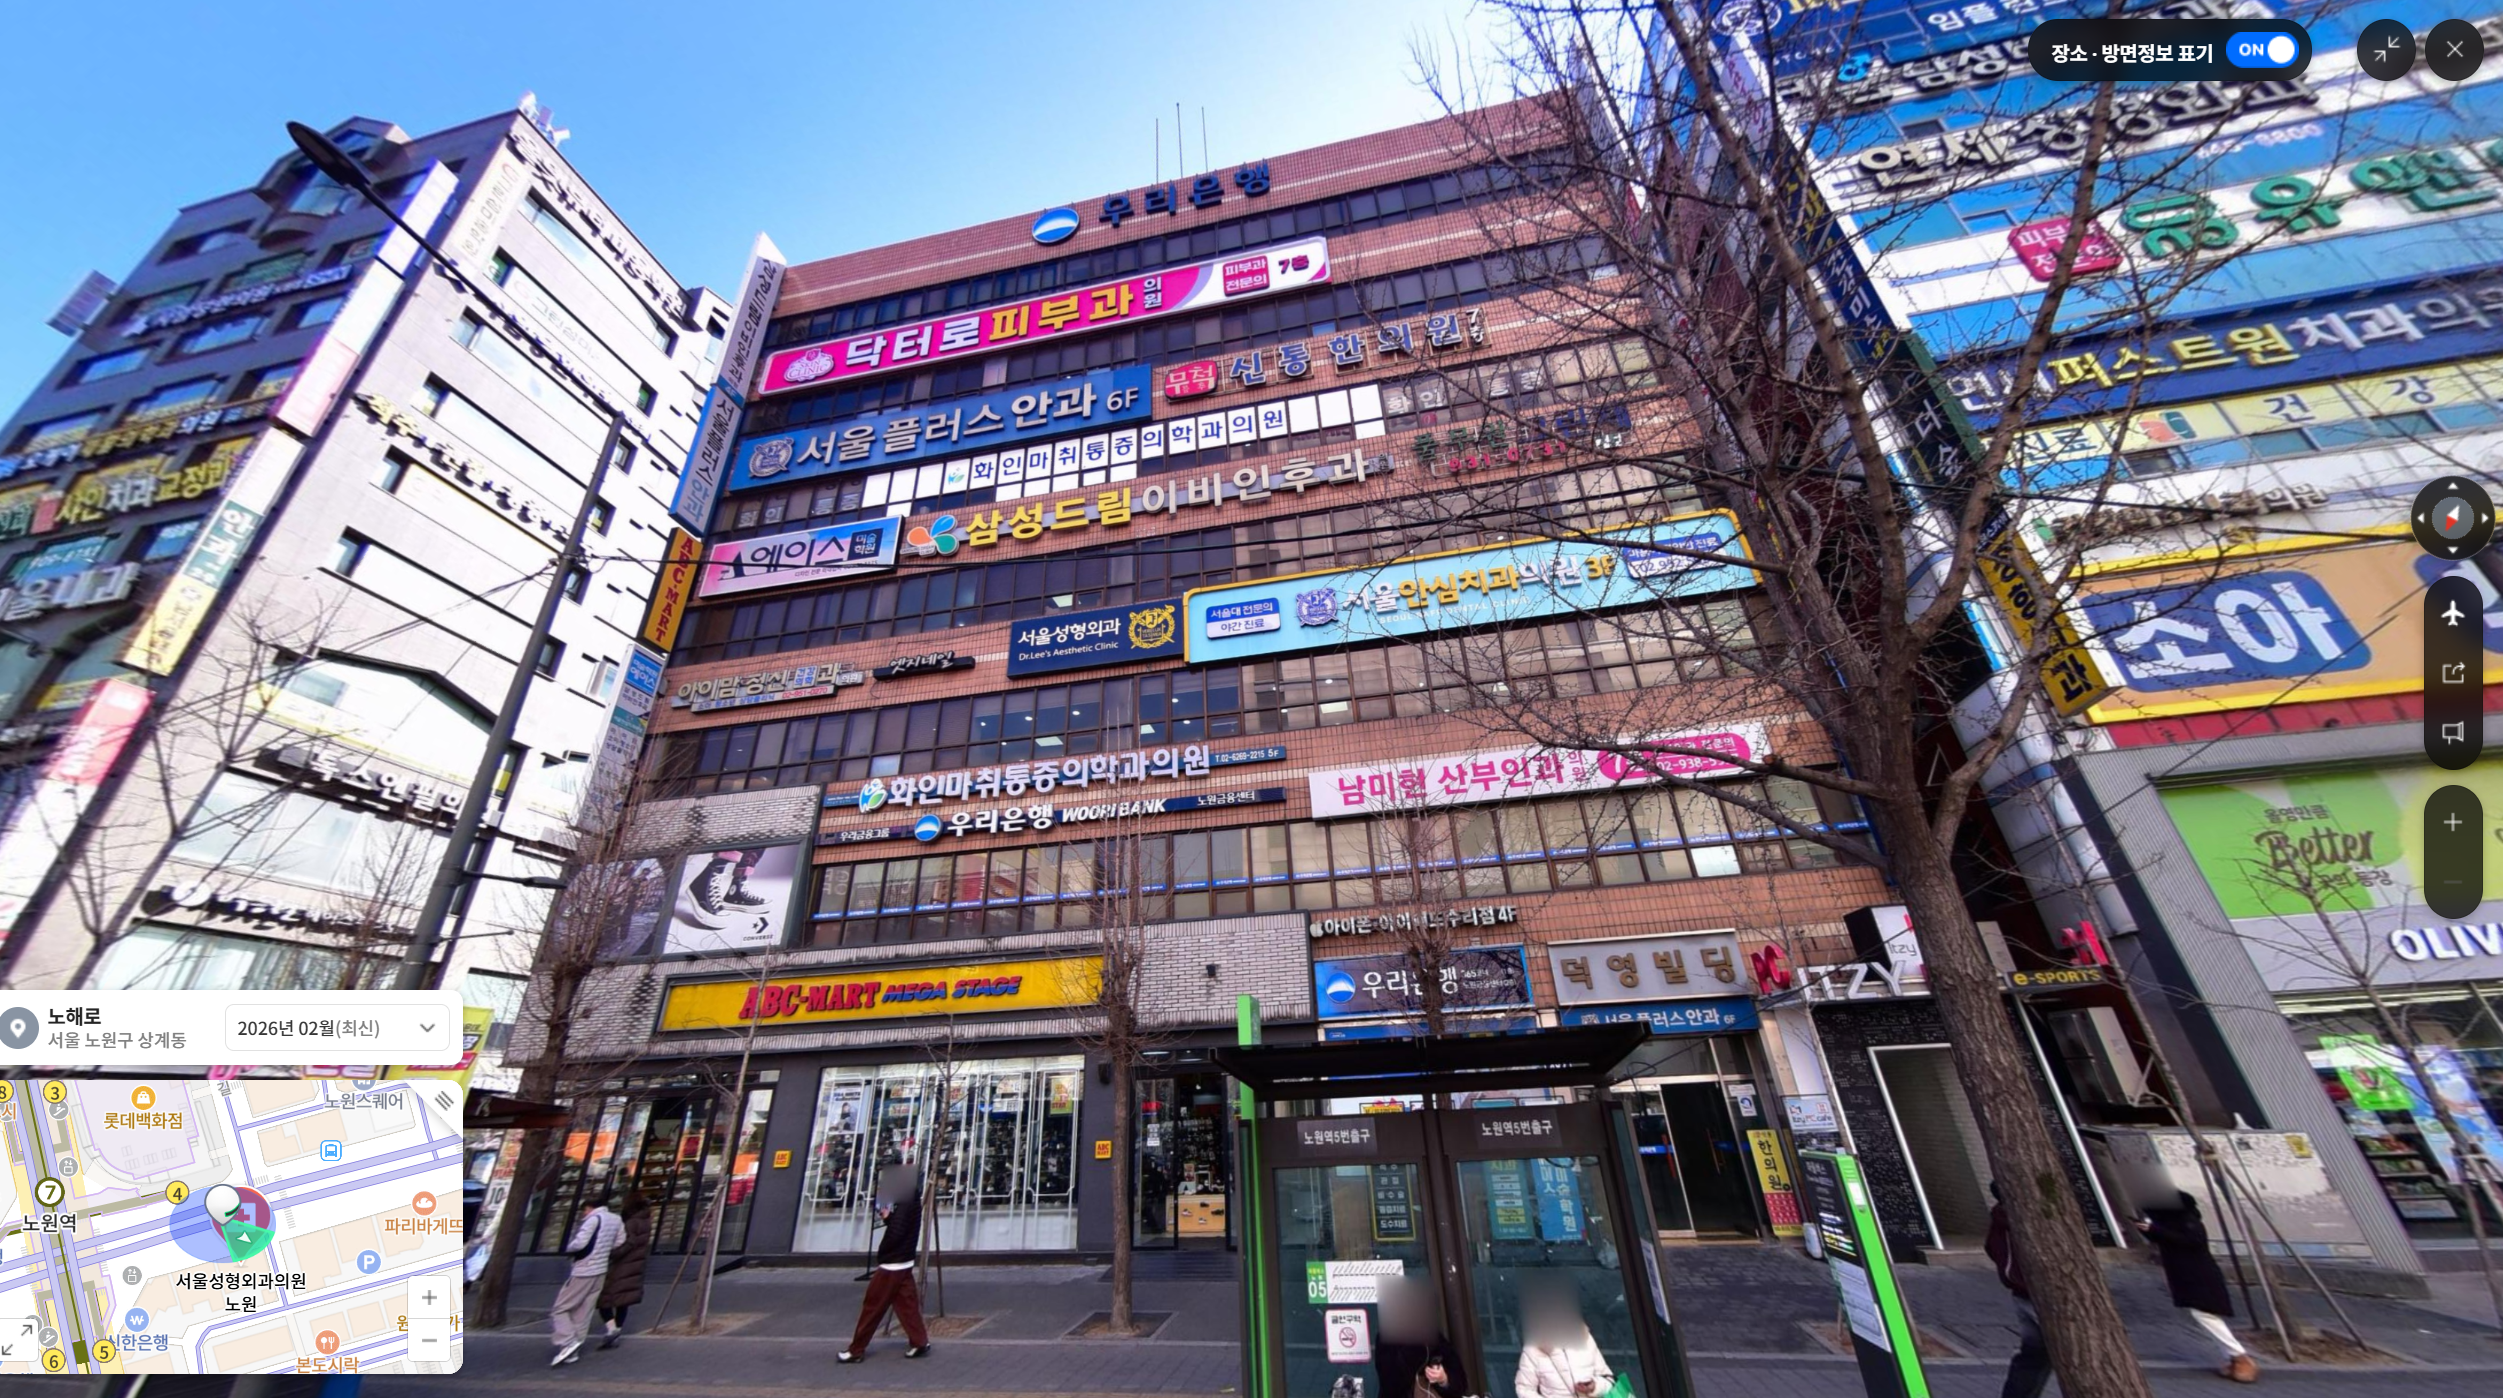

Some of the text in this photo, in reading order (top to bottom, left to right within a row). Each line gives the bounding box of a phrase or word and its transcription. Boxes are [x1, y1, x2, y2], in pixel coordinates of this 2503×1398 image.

[1100, 159, 1270, 227] 우리은행
[1224, 258, 1267, 276] 피부과
[1225, 274, 1268, 291] 전문의
[1143, 277, 1162, 309] 의원
[1166, 365, 1215, 395] 무척
[1107, 386, 1139, 412] 6F
[973, 409, 1285, 481] 화인마취통증의학과의원
[750, 536, 845, 573] 에이스
[655, 537, 694, 643] ABC-MART
[1343, 556, 1581, 612] 서울안심치과의원
[1211, 602, 1273, 619] 서울대 전문의
[1221, 618, 1265, 632] 야간 진료
[1018, 617, 1121, 648] 서울성형외과
[2113, 579, 2345, 681] 소아
[1019, 640, 1119, 662] Dr.Lee's Aesthetic Clinic
[888, 745, 1210, 807] 화인마취통증의학과의원
[1338, 765, 1428, 807] 남미현
[1437, 752, 1565, 797] 산부인과
[947, 790, 1256, 838] 우리은행 WOORI BANK 노원금융센터
[840, 827, 891, 842] 우리금융그룹
[2254, 825, 2375, 871] Better
[1498, 904, 1517, 921] 4F
[1362, 965, 1458, 999] 우리행
[1561, 944, 1735, 989] 덕영빌딩
[1797, 960, 1907, 1001] ITZY
[2013, 968, 2101, 987] e-SPORTS
[739, 975, 1023, 1019] ABC-MART MEGA STAGE
[1304, 1127, 1371, 1146] 노원역5번출구
[1481, 1118, 1553, 1137] 노원역5번출구
[1758, 1138, 1784, 1192] 한의원
[1308, 1281, 1327, 1298] 05
